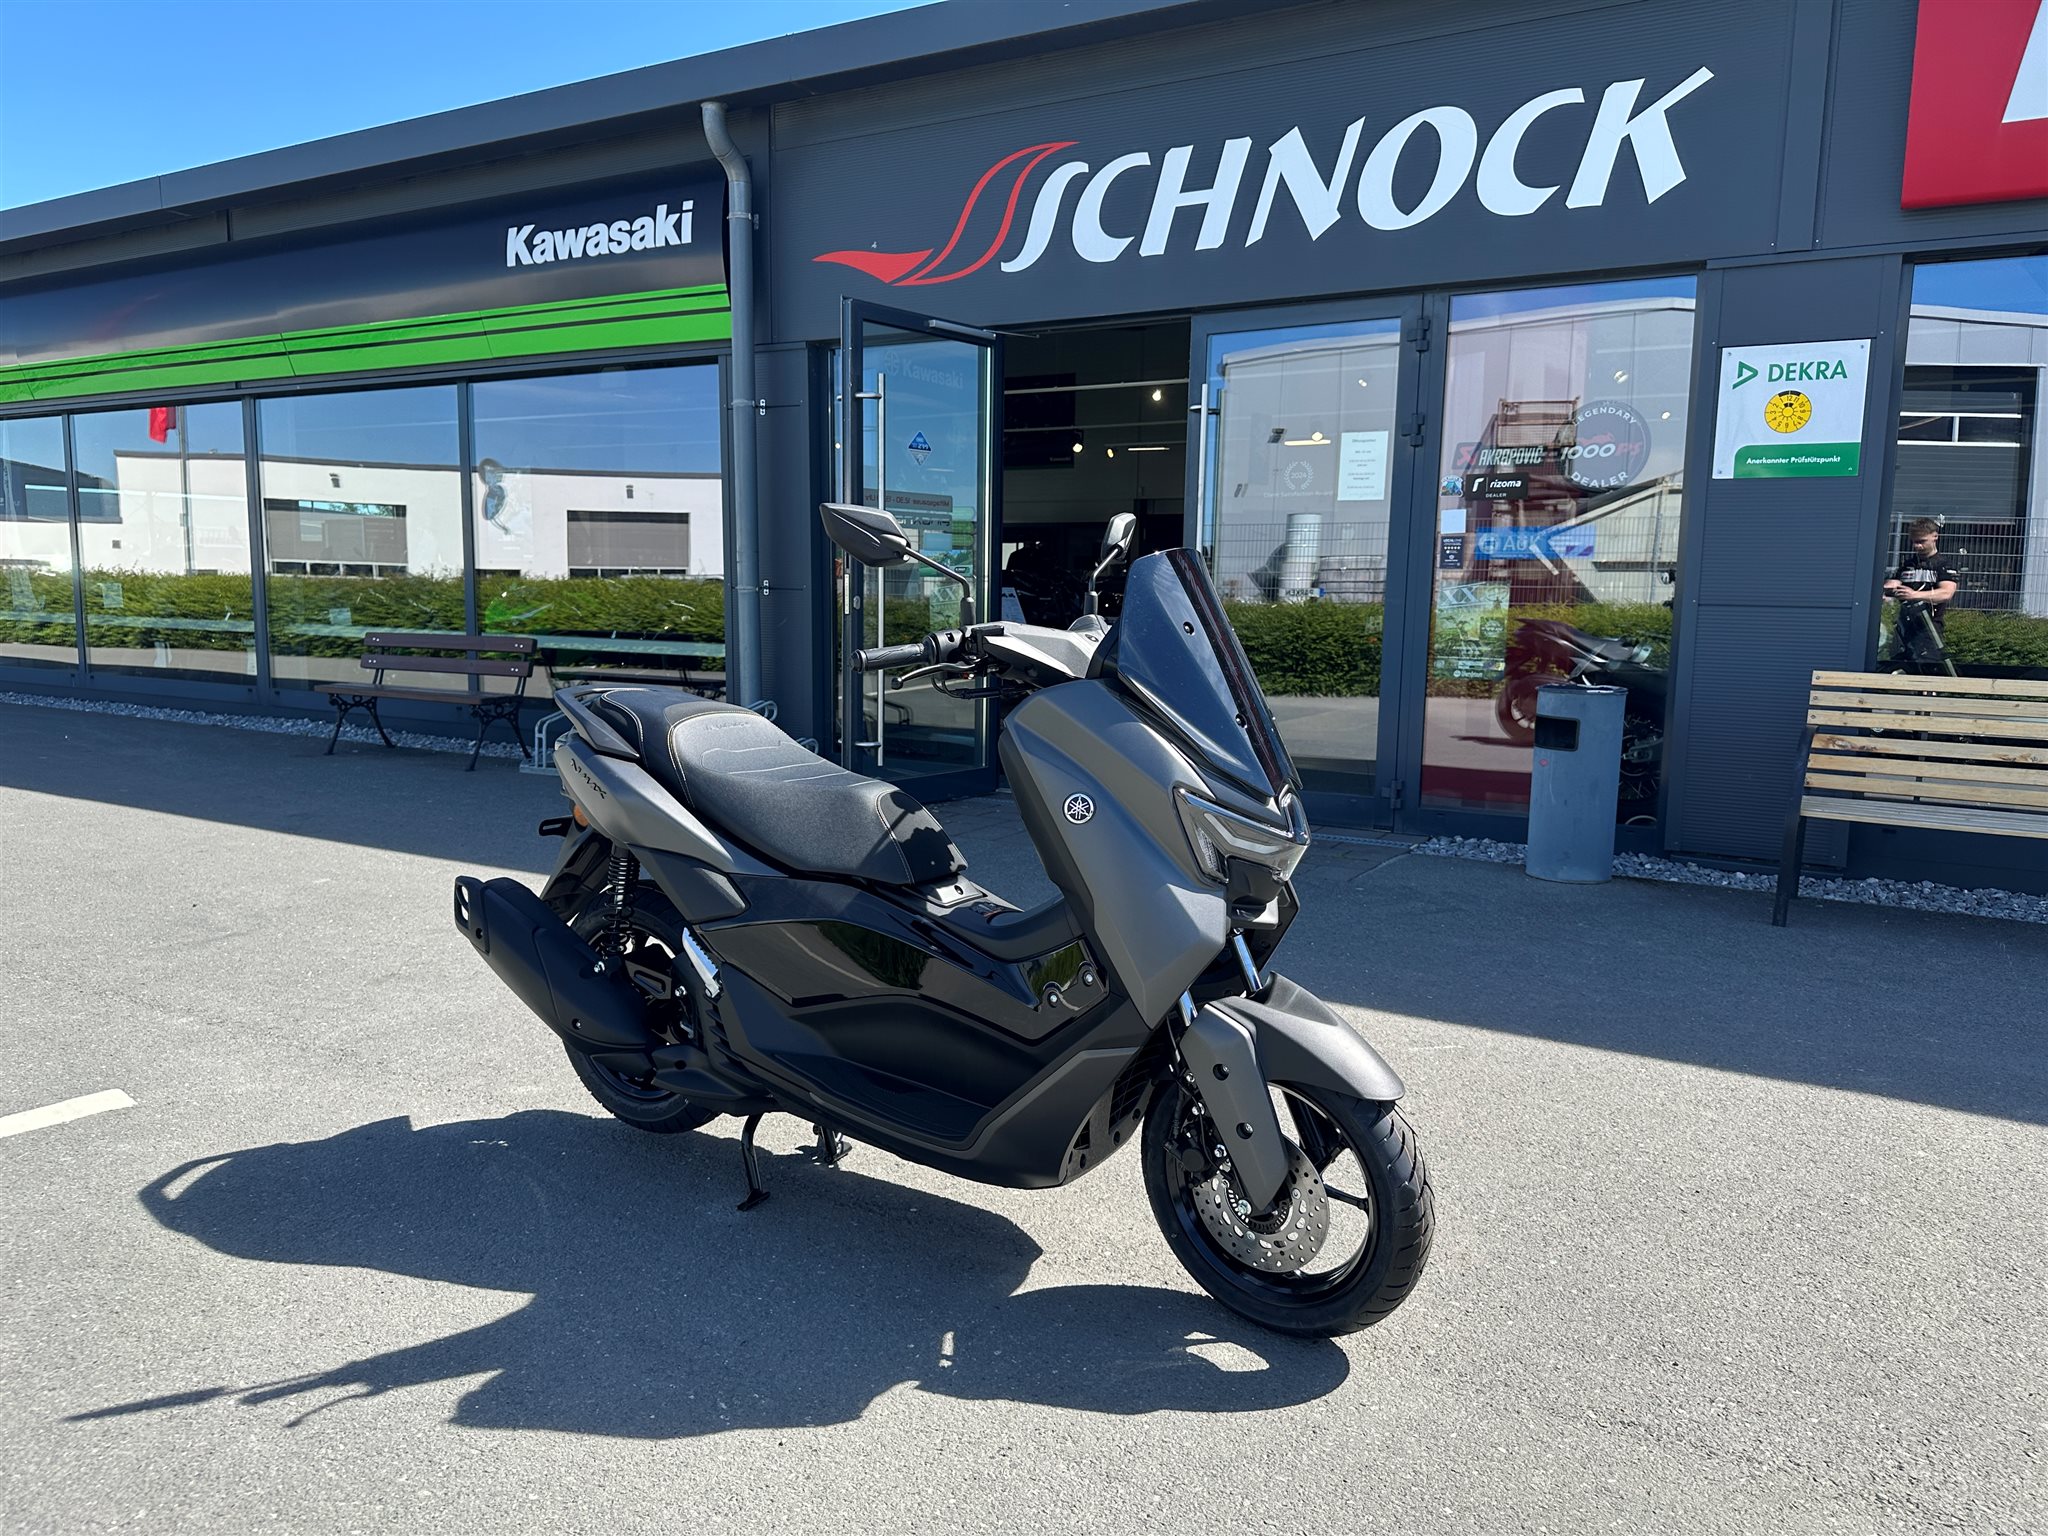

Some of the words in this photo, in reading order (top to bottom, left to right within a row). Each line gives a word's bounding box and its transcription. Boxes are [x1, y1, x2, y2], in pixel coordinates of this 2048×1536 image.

[1000, 66, 1714, 273] SCHNOCK
[506, 200, 694, 267] Kawasaki
[902, 360, 965, 390] Kawasaki
[1768, 359, 1848, 382] DEKRA
[1574, 406, 1637, 426] LEGENDARY
[1746, 457, 1789, 465] Anerkannter
[1790, 455, 1841, 465] Prüfstützpunkt
[1489, 478, 1522, 489] rizoma
[1570, 471, 1629, 488] DEALER
